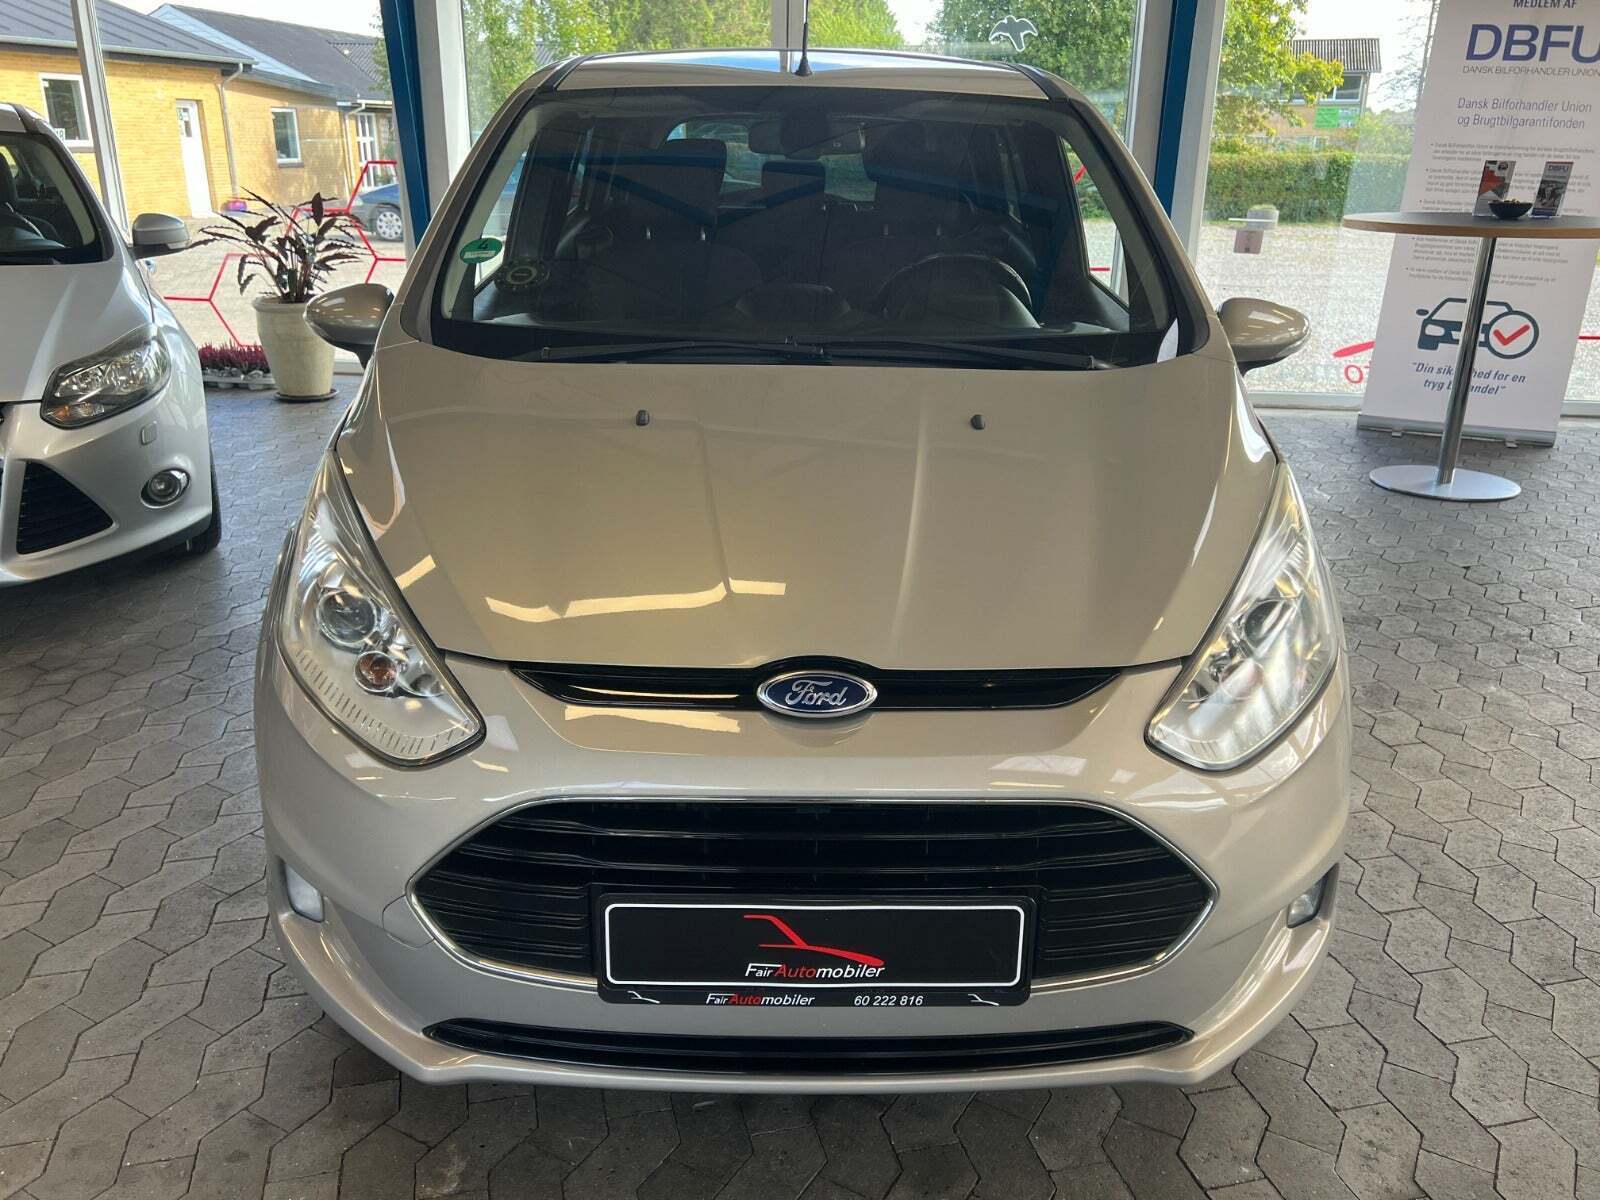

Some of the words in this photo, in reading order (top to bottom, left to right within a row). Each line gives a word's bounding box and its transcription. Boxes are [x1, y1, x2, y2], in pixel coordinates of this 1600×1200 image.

[1465, 24, 1600, 64] DBFU
[1462, 65, 1494, 74] DANSK
[1495, 66, 1571, 76] BILFORHANDLER
[1457, 97, 1488, 109] Dansk
[1491, 98, 1559, 112] Bilforhandler
[1561, 100, 1592, 113] Union
[1457, 115, 1470, 127] og
[1472, 114, 1585, 129] Brugtbilgarantifonden
[478, 239, 489, 250] 4
[1493, 369, 1511, 382] for
[1511, 374, 1526, 383] en
[785, 679, 848, 706] Ford
[854, 995, 871, 1006] 60
[872, 995, 897, 1006] 222
[899, 995, 924, 1006] 816
